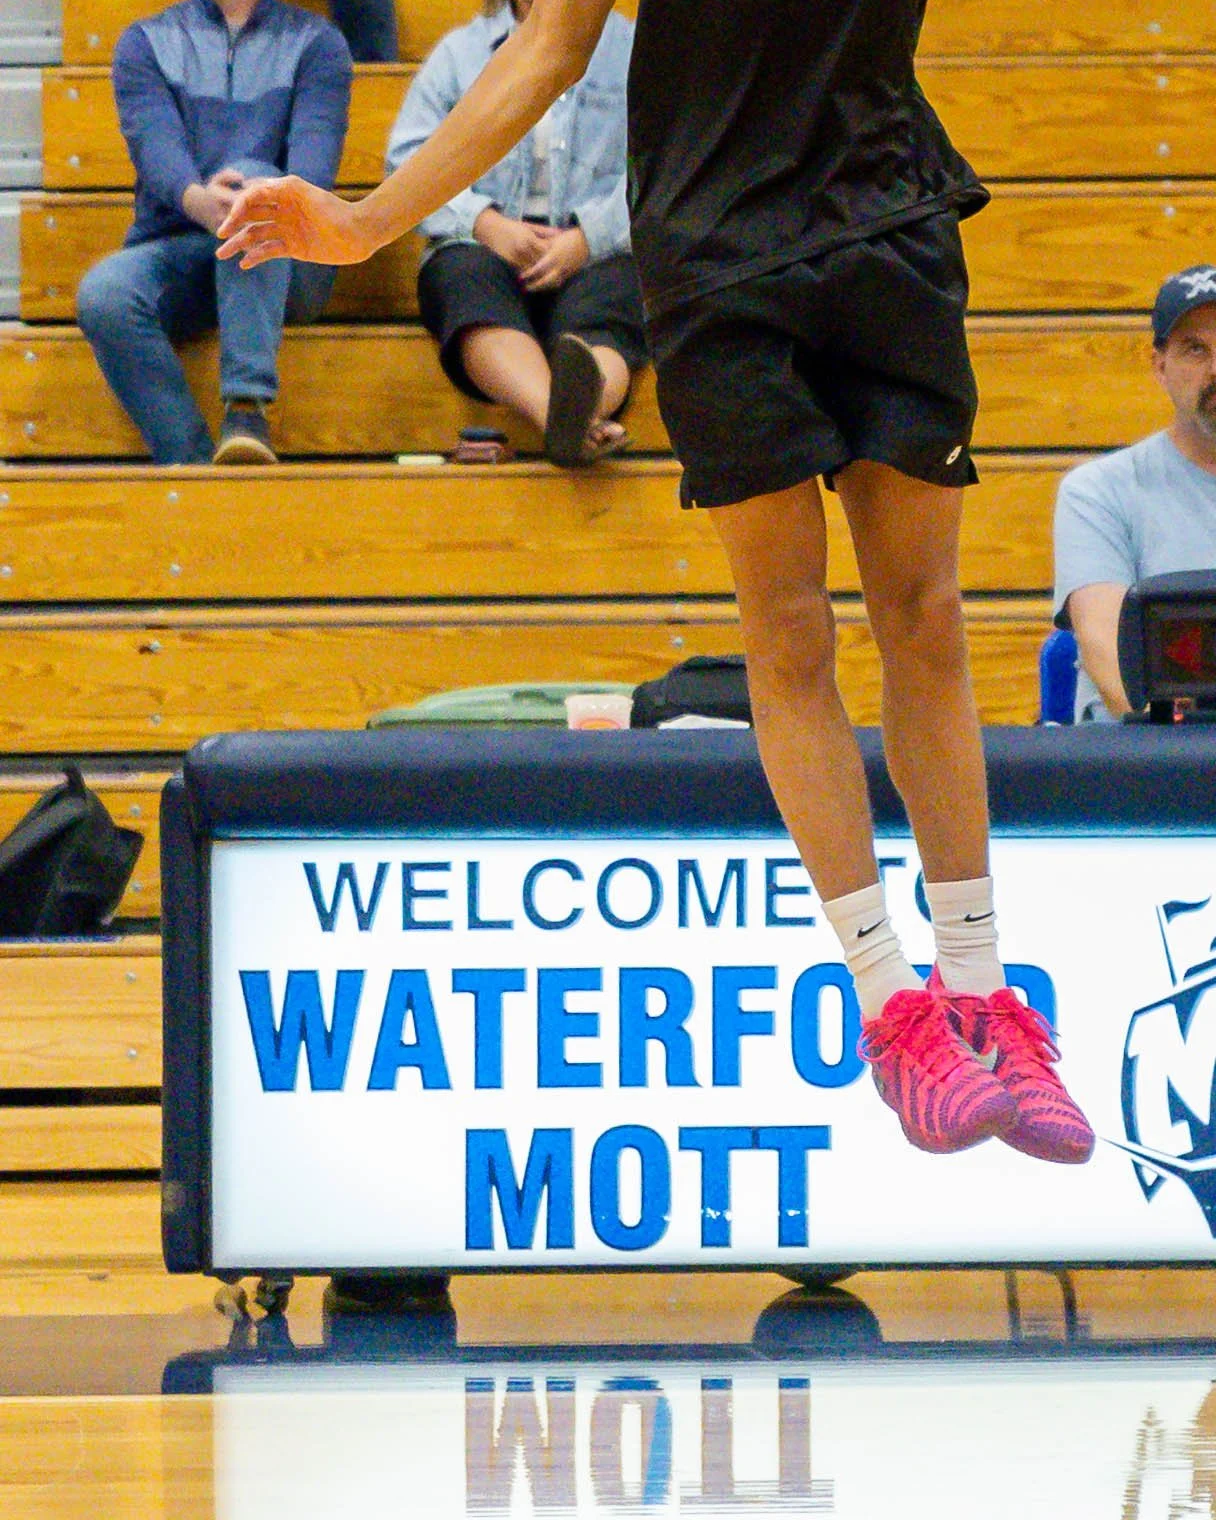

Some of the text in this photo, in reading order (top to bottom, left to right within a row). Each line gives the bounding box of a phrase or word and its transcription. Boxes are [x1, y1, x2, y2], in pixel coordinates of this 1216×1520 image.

[303, 857, 816, 933] WELCOME
[239, 963, 1058, 1093] WATERFO
[464, 1124, 832, 1252] MOTT
